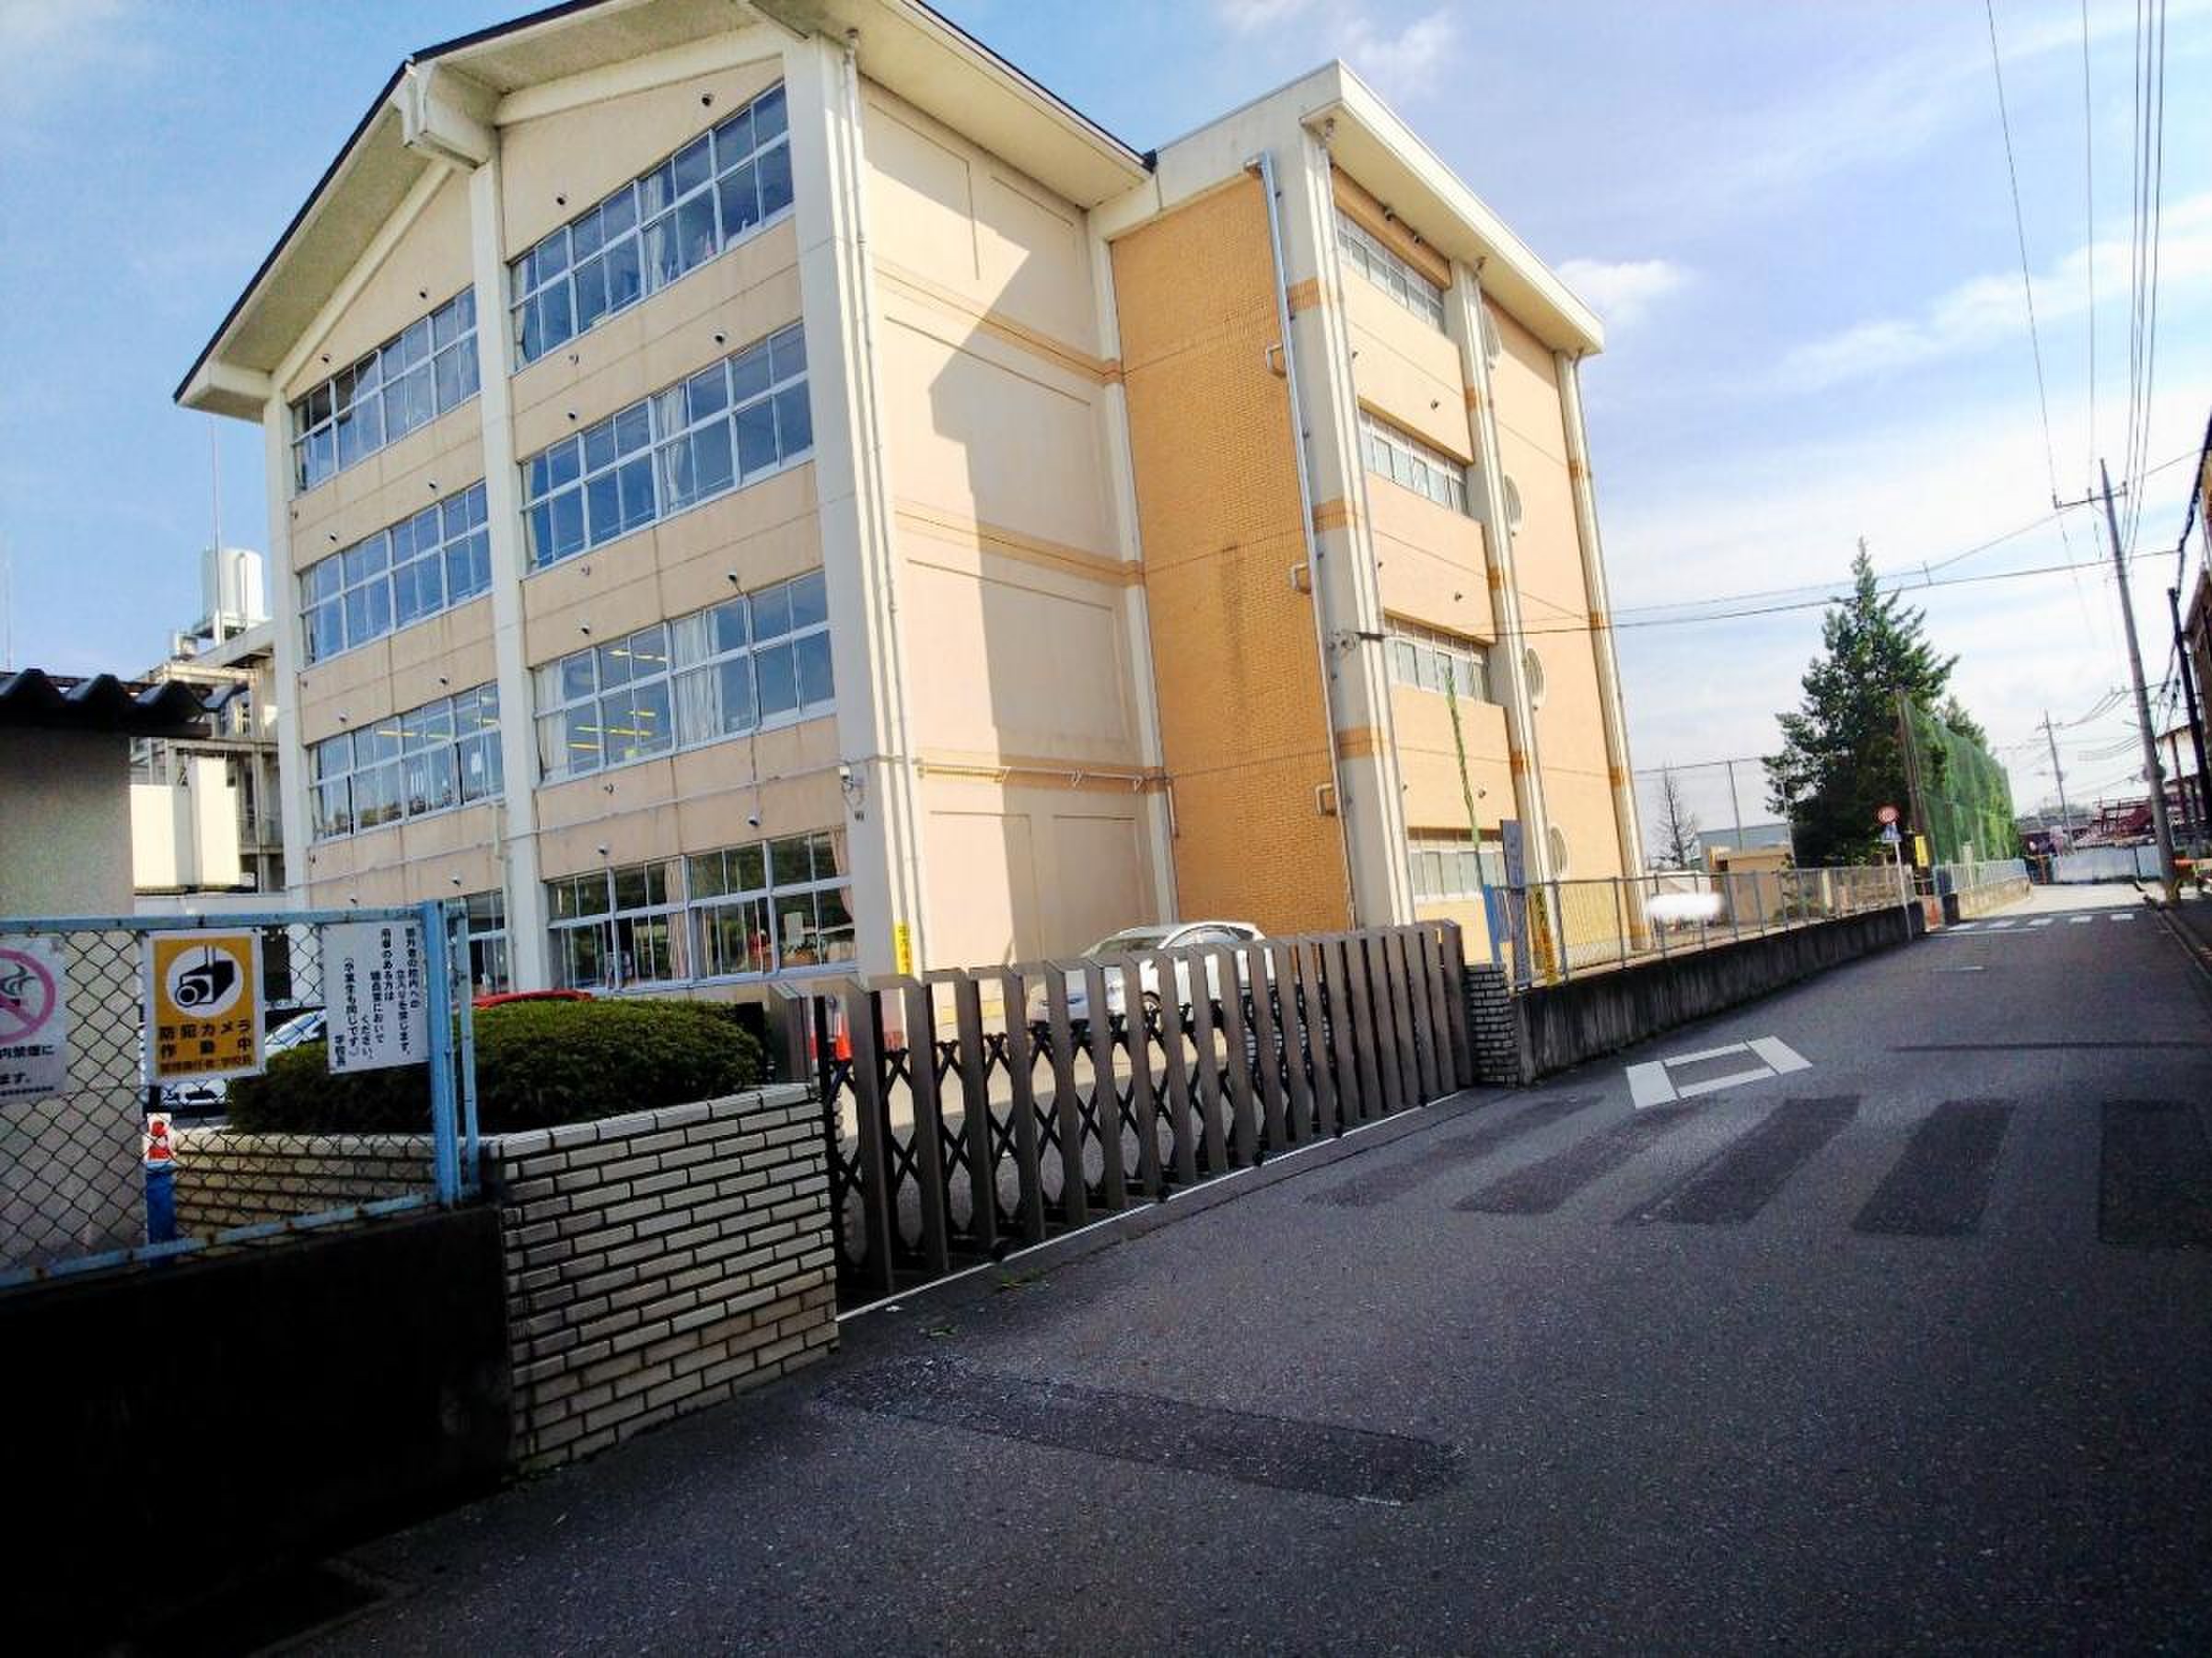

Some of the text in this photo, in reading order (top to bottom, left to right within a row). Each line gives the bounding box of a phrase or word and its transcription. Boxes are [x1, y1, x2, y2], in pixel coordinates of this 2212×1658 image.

[158, 1018, 251, 1041] 防犯カメラ
